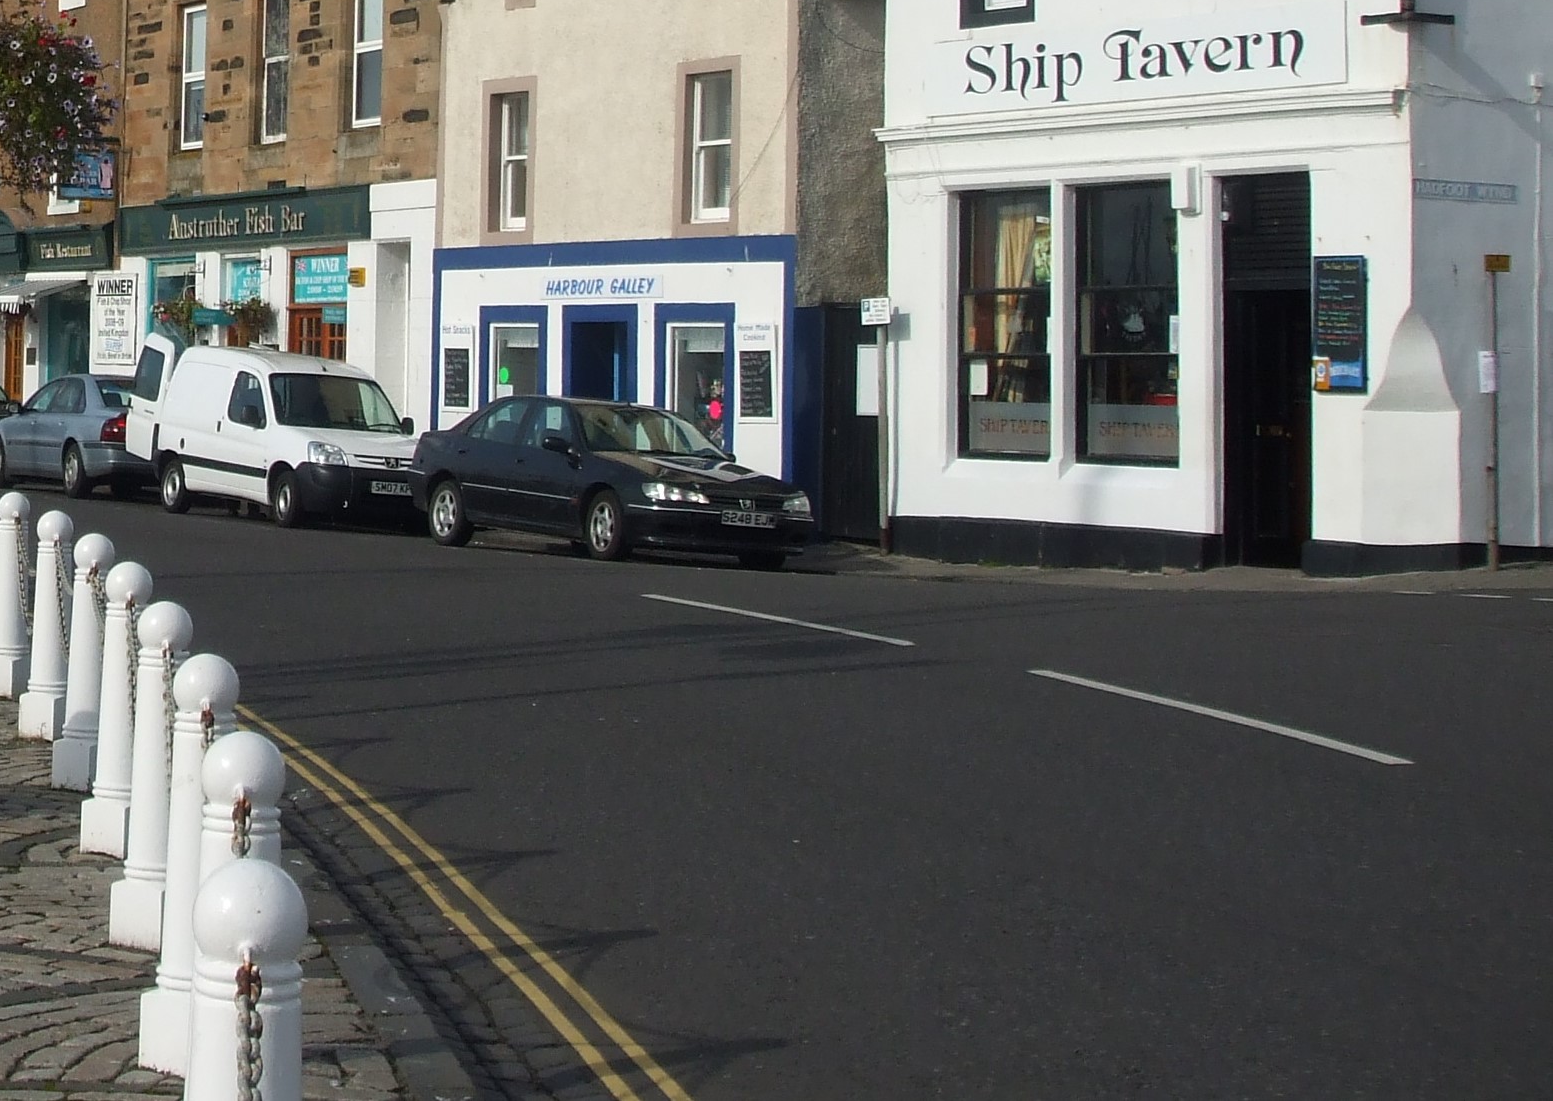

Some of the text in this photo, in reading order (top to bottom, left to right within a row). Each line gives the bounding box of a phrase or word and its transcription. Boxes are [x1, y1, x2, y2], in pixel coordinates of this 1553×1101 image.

[964, 27, 1305, 104] Ship Tavern
[168, 205, 306, 241] Anstruther Fish Bar
[40, 242, 92, 259] Fish Restaurant
[311, 258, 340, 273] WINNER
[97, 279, 134, 294] WINNER
[546, 277, 655, 296] HARBOUR GALLEY
[442, 326, 471, 335] Hot Snacks
[980, 418, 1049, 435] SHIP TAVER
[1098, 421, 1177, 439] SHIP TAVER
[722, 511, 752, 524] S248
